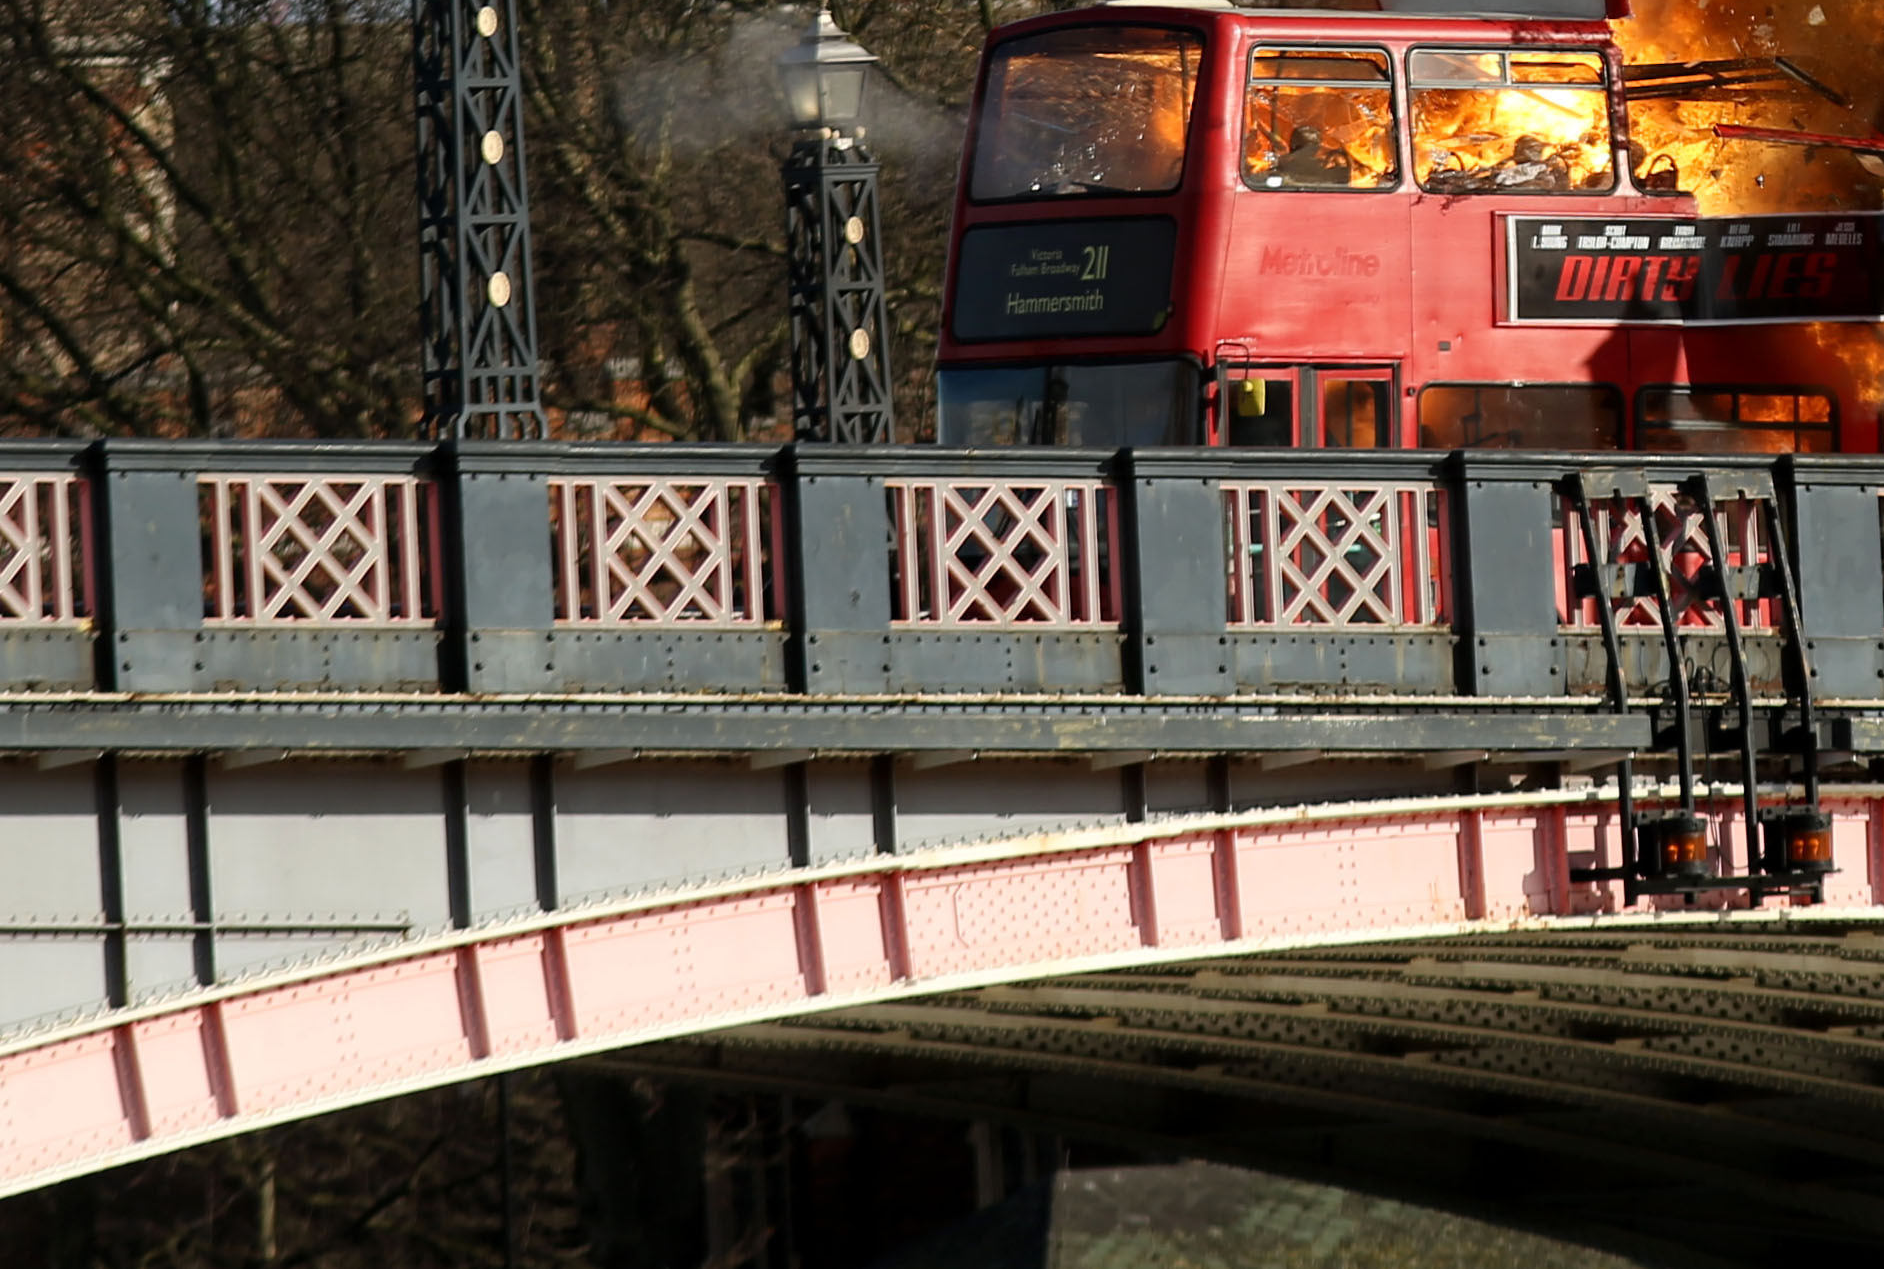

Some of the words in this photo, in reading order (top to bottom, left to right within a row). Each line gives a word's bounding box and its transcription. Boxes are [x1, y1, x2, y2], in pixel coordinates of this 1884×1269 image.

[1081, 245, 1109, 280] 211
[1554, 255, 1702, 301] DIRTY
[1715, 252, 1837, 300] LIES
[1007, 288, 1104, 314] Hammersmith
